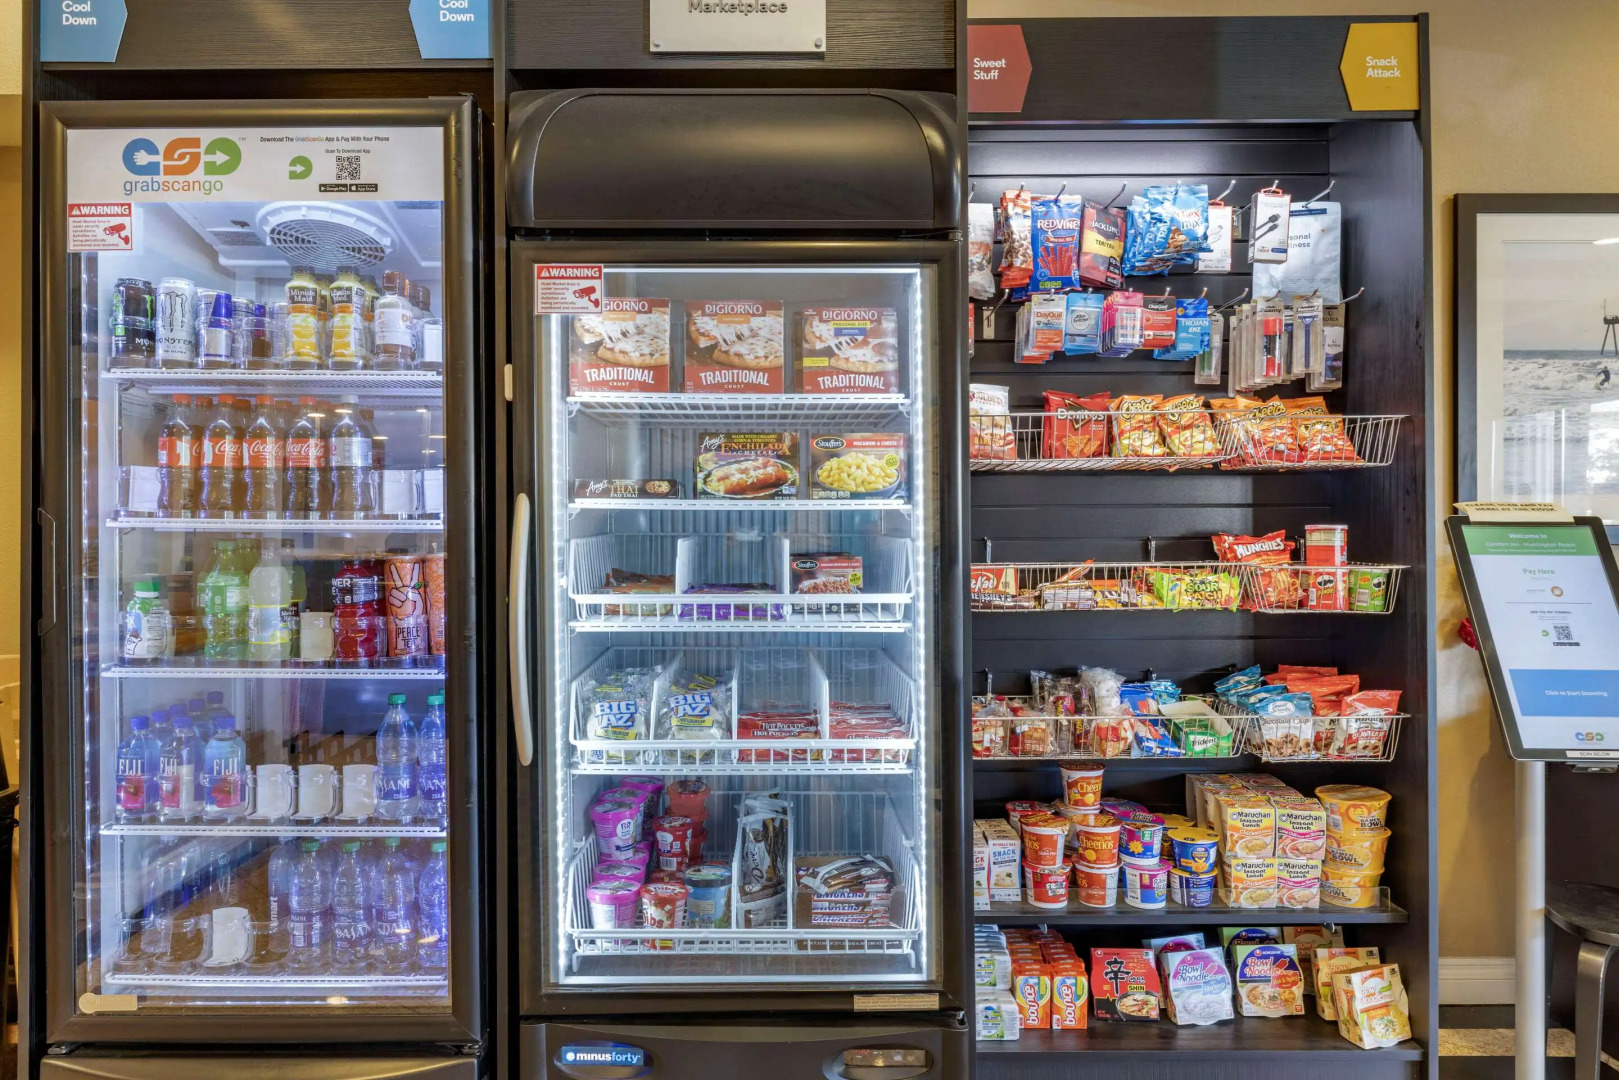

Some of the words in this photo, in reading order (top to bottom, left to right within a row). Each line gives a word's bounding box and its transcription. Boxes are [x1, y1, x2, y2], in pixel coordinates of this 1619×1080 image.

[62, 0, 92, 12] Cool
[438, 0, 470, 9] Cool
[688, 0, 788, 16] Marketplace
[62, 13, 98, 25] Down
[439, 10, 475, 22] Down
[973, 57, 1007, 68] Sweet
[1366, 56, 1398, 66] Snack
[973, 69, 999, 80] Stuff
[1366, 67, 1402, 78] Attack
[325, 136, 335, 144] App
[341, 136, 350, 144] Pay
[123, 176, 223, 195] grabscango
[80, 205, 129, 215] WARNING
[1091, 220, 1107, 231] JACK
[1288, 233, 1311, 241] sonal
[549, 267, 600, 277] WARNING
[290, 288, 316, 298] Minute
[294, 295, 313, 303] Maid
[602, 300, 649, 313] GIORNO
[705, 303, 763, 316] DIGIORNO
[822, 309, 879, 321] DIGIORNO
[1036, 311, 1062, 321] DayQuil
[583, 365, 655, 385] TRADITIONAL
[699, 369, 770, 387] TRADITIONAL
[817, 373, 886, 391] TRADITIONAL
[1057, 407, 1106, 422] Doritos
[700, 433, 725, 452] Amy's
[817, 439, 844, 449] Stouffer's
[721, 443, 791, 457] ENCHILADA
[586, 479, 609, 496] Amy's
[608, 484, 639, 494] THAI
[1233, 538, 1285, 560] MUNCHIES
[1524, 542, 1558, 550] Huntington
[1522, 568, 1537, 576] Pay
[331, 578, 352, 588] WER
[1186, 582, 1219, 593] SOUR
[397, 626, 421, 639] PEACE
[667, 692, 711, 708] BIG
[1567, 690, 1581, 698] Start
[1580, 690, 1609, 699] Scanning
[595, 700, 637, 716] BIG
[676, 703, 706, 718] AZ
[601, 714, 634, 729] AZ
[761, 722, 777, 730] HOT
[1191, 736, 1217, 748] Trident
[118, 758, 143, 776] FIJI
[160, 757, 178, 776] FIJI
[213, 758, 239, 776] FIJI
[1077, 781, 1103, 793] Cheeri
[1237, 811, 1271, 820] Maruchan
[1286, 813, 1323, 823] Maruchan
[1079, 836, 1114, 850] Cheerios
[992, 848, 1016, 858] SNACK
[1331, 854, 1360, 864] BOWL
[1241, 862, 1274, 871] Maruchan
[1284, 862, 1319, 872] Maruchan
[1247, 957, 1274, 968] Bowl
[1180, 962, 1203, 976] Bowl
[1244, 966, 1280, 978] Noodle
[1104, 956, 1132, 997] 辛
[1177, 973, 1209, 985] Noodle
[1024, 984, 1041, 1027] bounce
[1061, 984, 1078, 1027] bounce
[576, 1051, 639, 1064] minusforty
